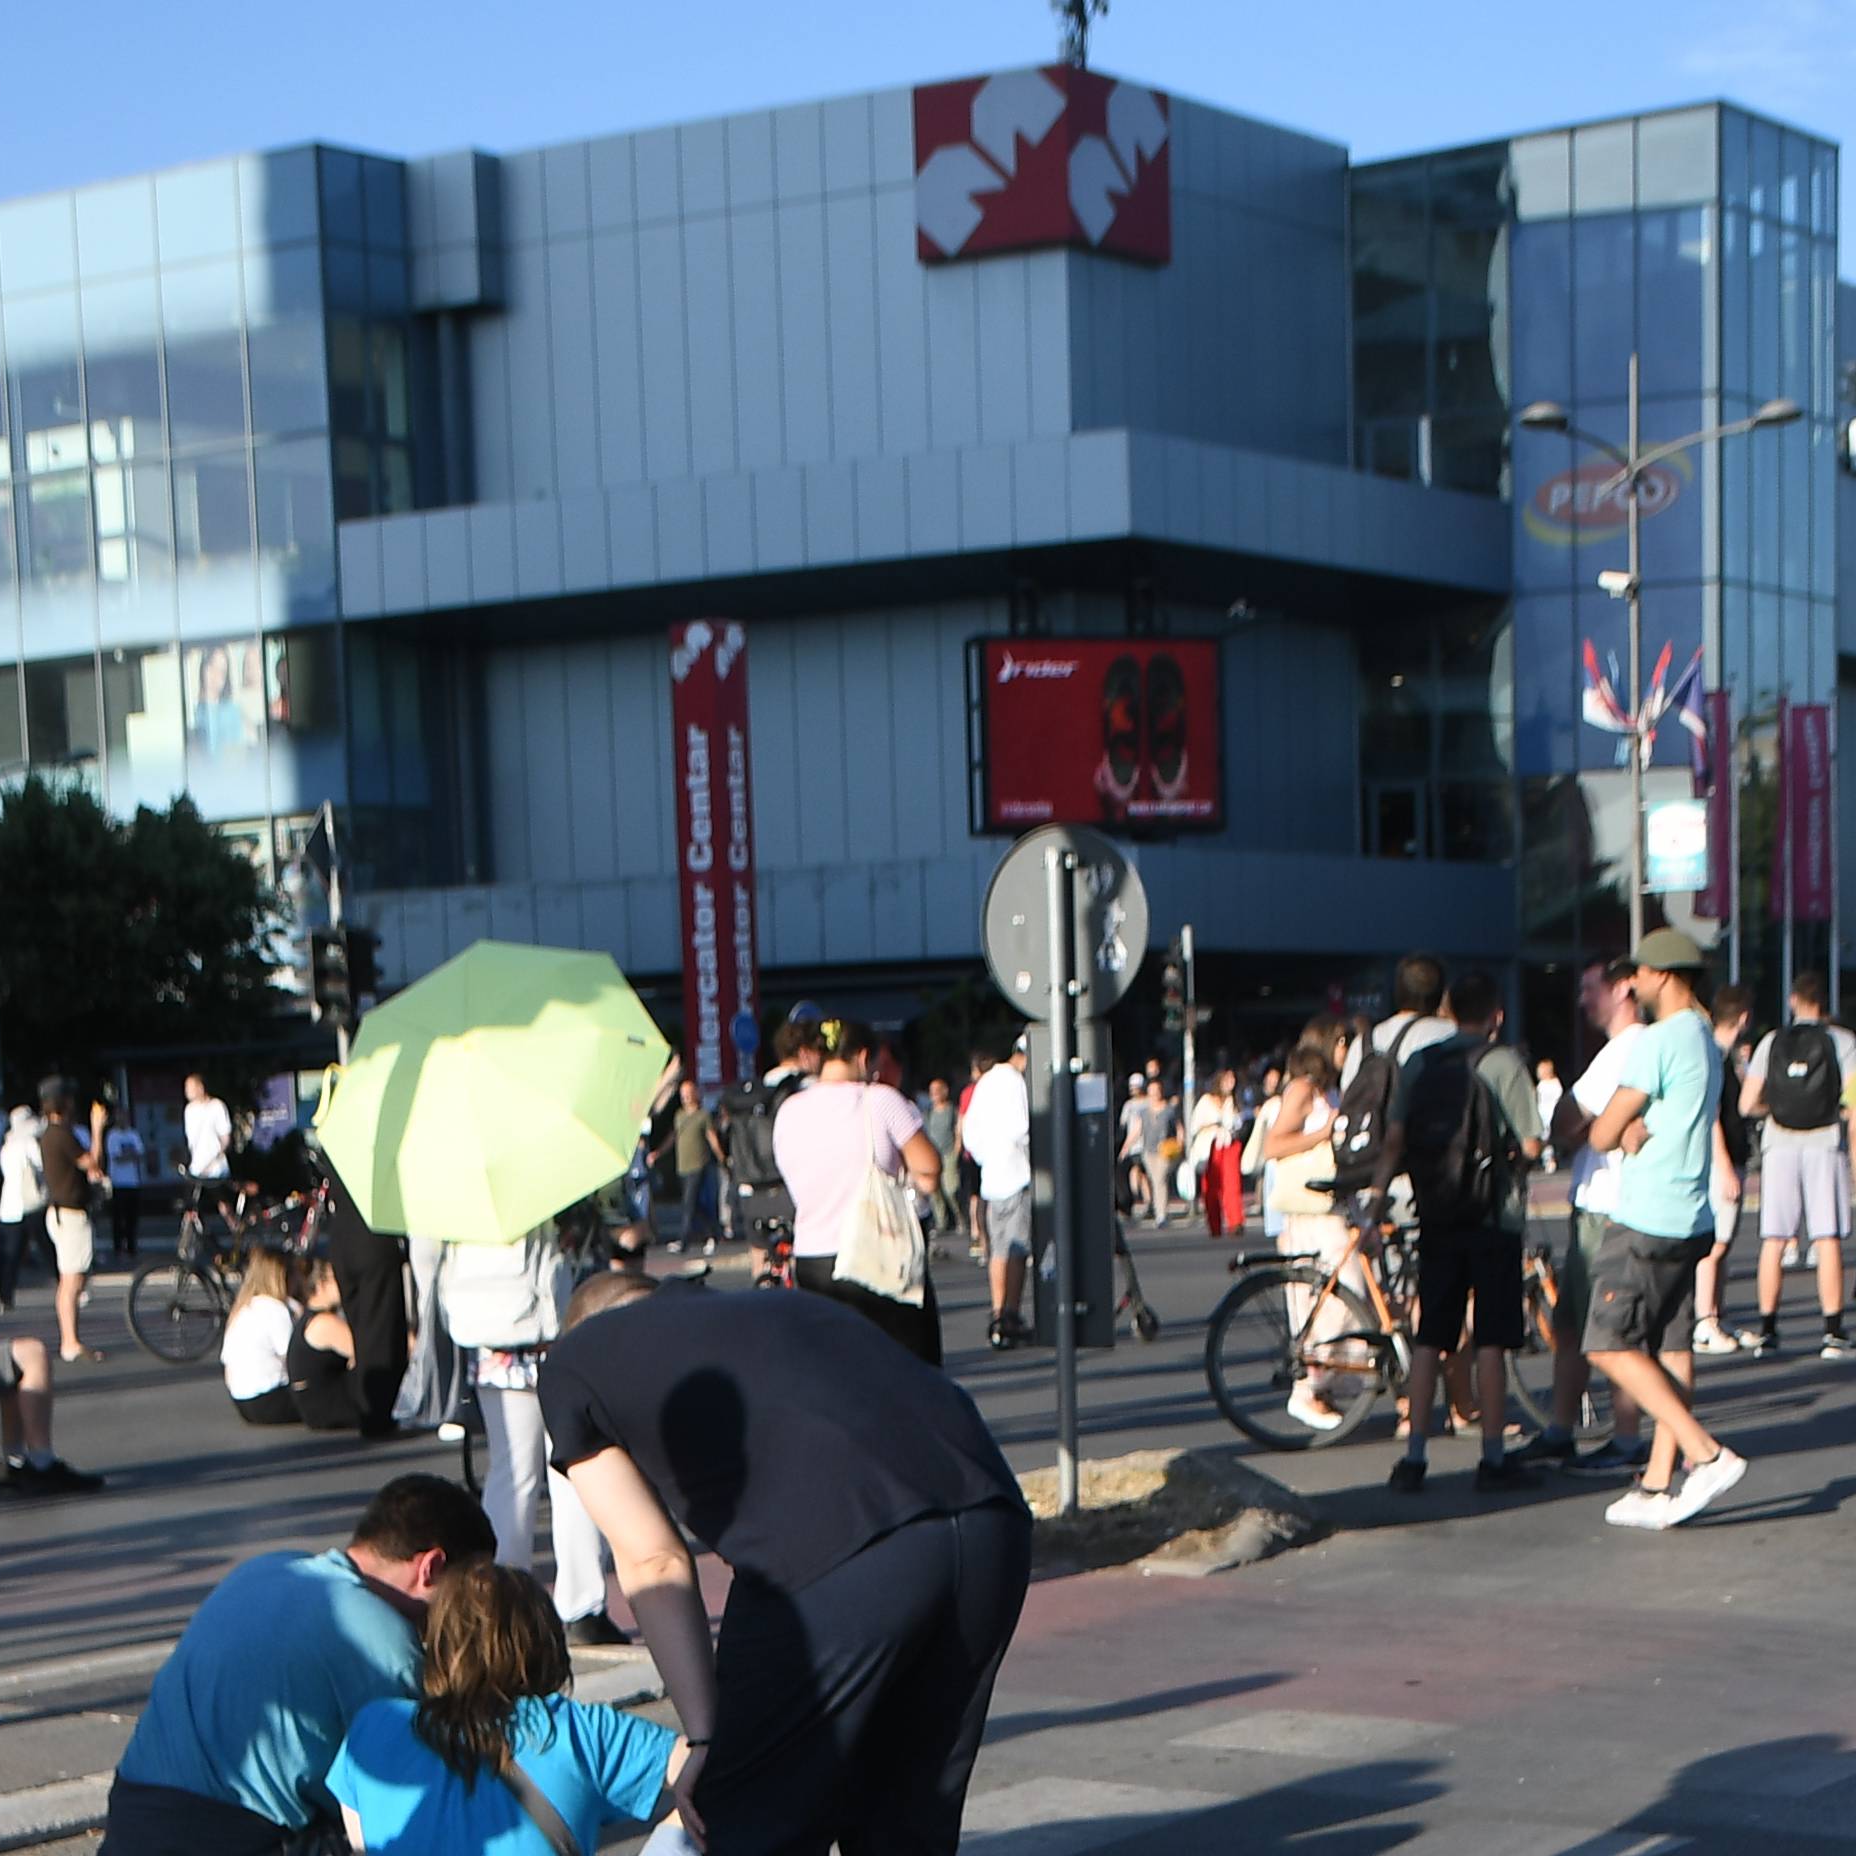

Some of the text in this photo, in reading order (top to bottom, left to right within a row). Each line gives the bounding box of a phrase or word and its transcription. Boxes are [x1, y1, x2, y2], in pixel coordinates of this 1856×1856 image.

[685, 724, 722, 1083] Mercator Centar
[727, 725, 748, 873] Centar
